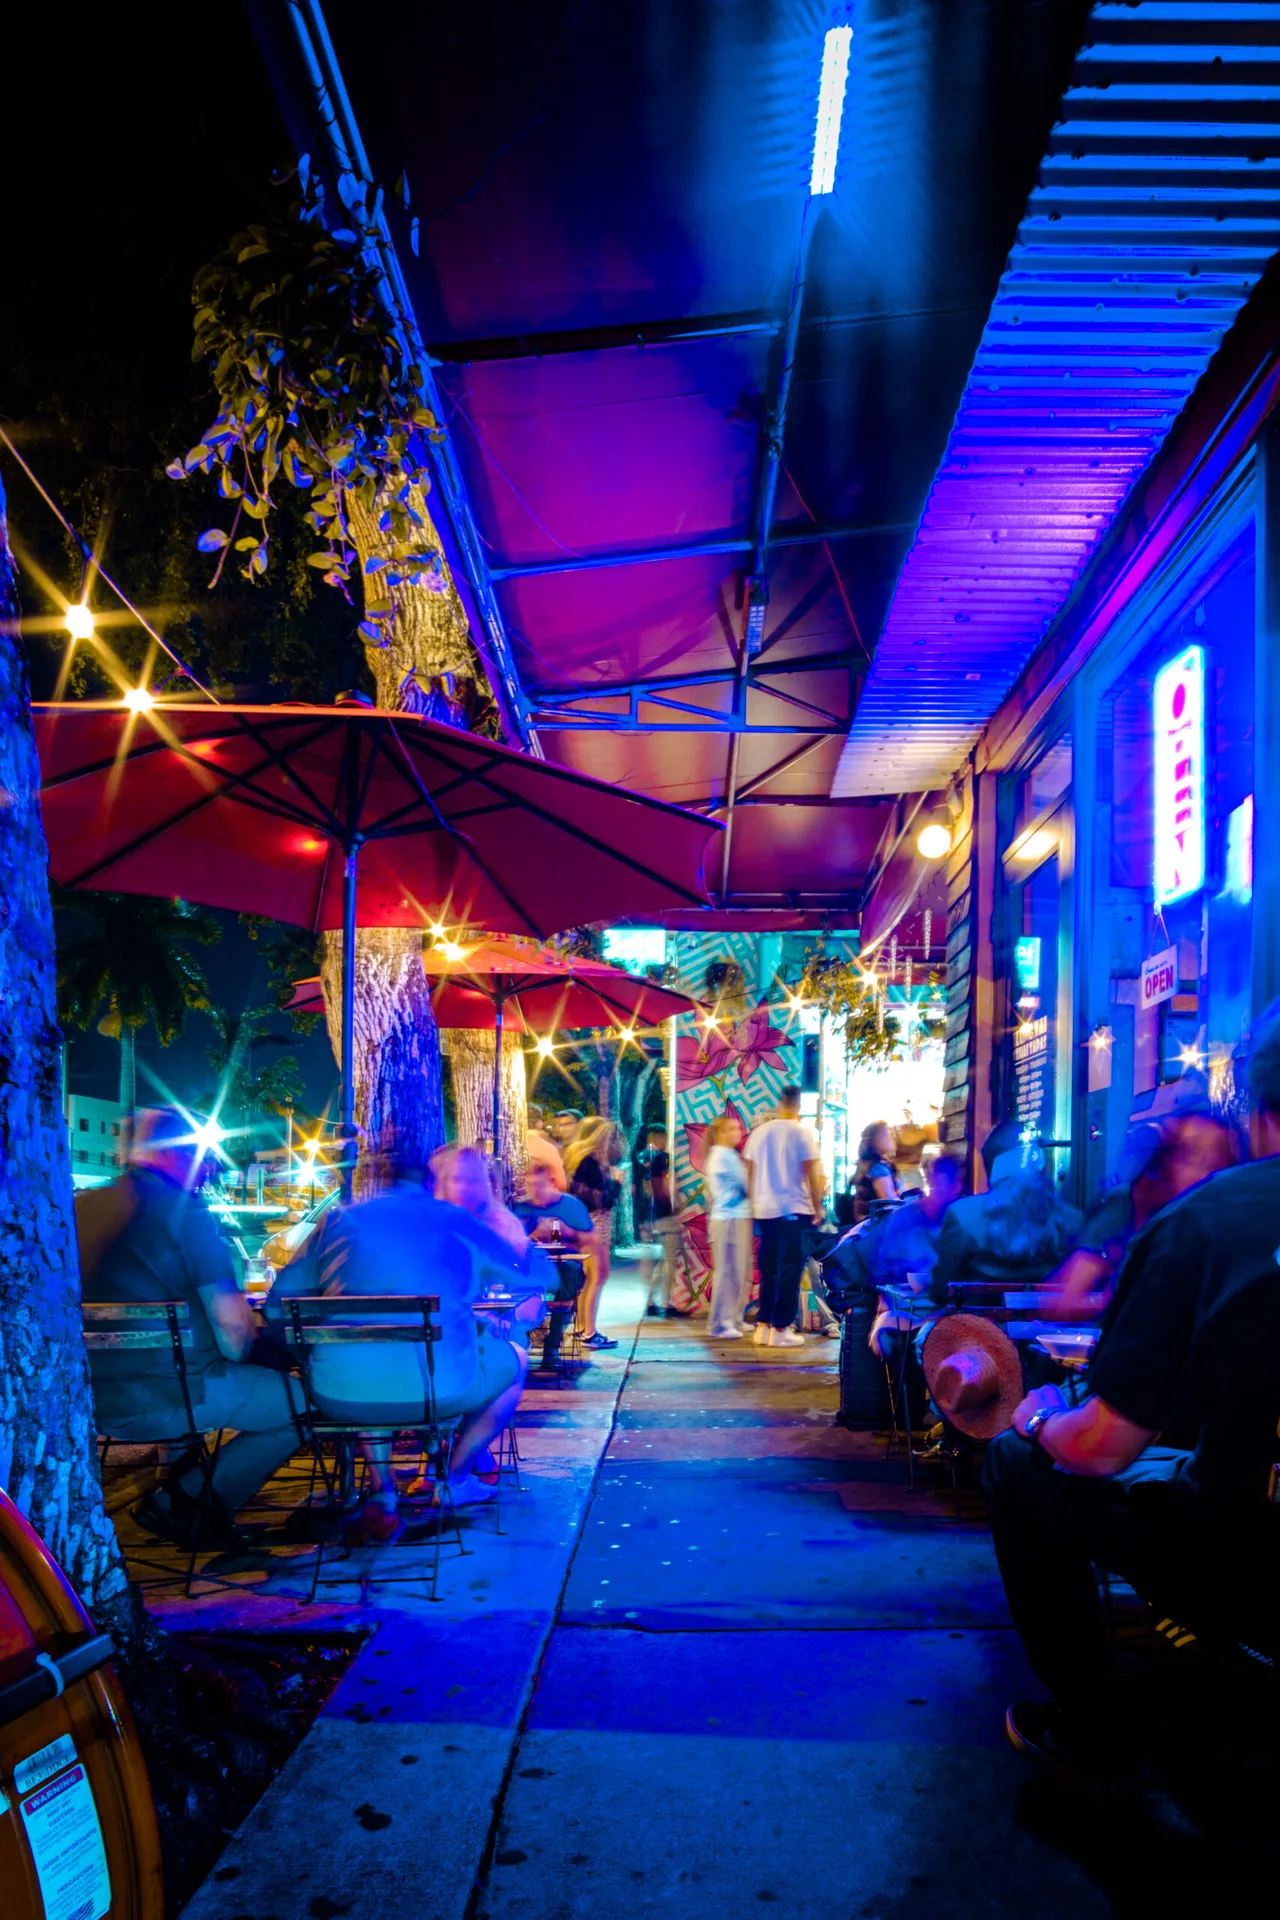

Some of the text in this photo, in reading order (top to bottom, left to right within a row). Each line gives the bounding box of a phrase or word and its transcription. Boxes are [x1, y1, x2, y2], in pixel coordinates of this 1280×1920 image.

[1145, 965, 1173, 999] OPEN
[30, 1774, 77, 1809] WARNING
[48, 1806, 75, 1828] CAUTION
